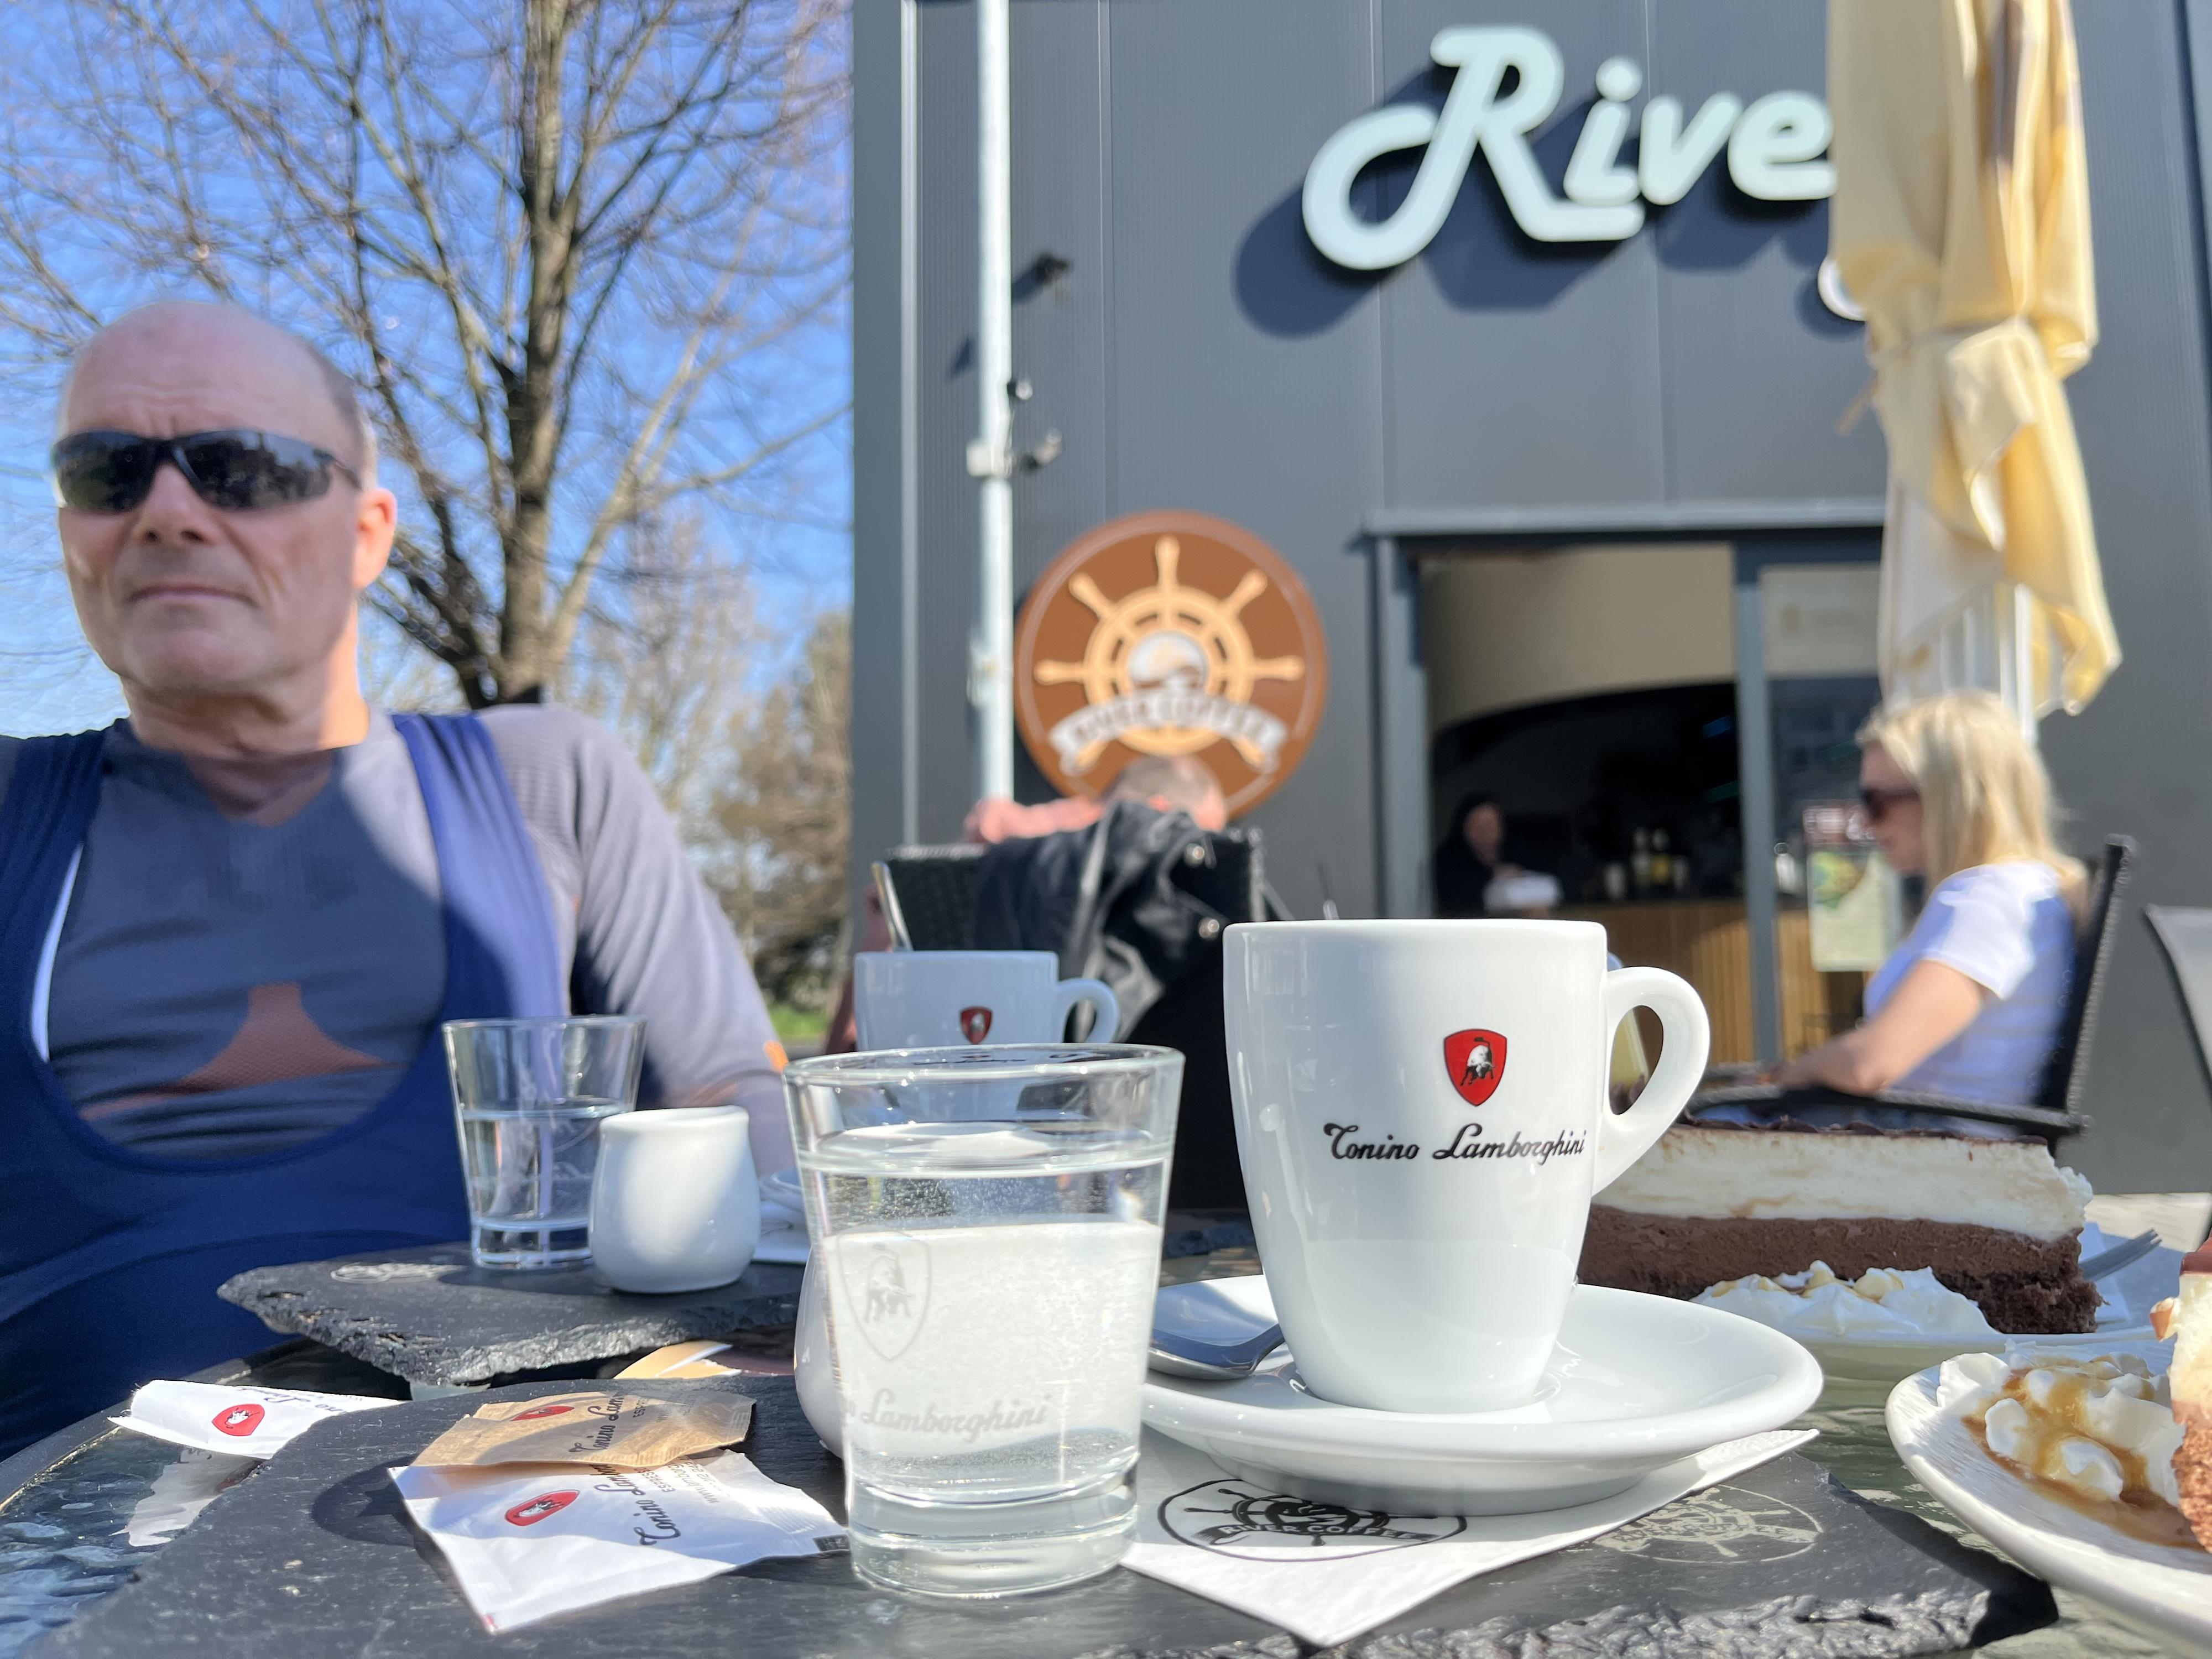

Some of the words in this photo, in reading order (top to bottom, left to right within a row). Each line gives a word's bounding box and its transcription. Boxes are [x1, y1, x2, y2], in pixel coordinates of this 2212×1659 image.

[1301, 24, 1837, 271] Rive
[1323, 1123, 1420, 1160] Tonino
[1432, 1123, 1587, 1166] Lamborghini
[859, 1387, 1053, 1444] Lamborghini
[568, 1425, 616, 1453] Tonino
[633, 1499, 682, 1546] Tonino
[1219, 1524, 1296, 1535] RIVER
[1307, 1525, 1417, 1540] COFFEE
